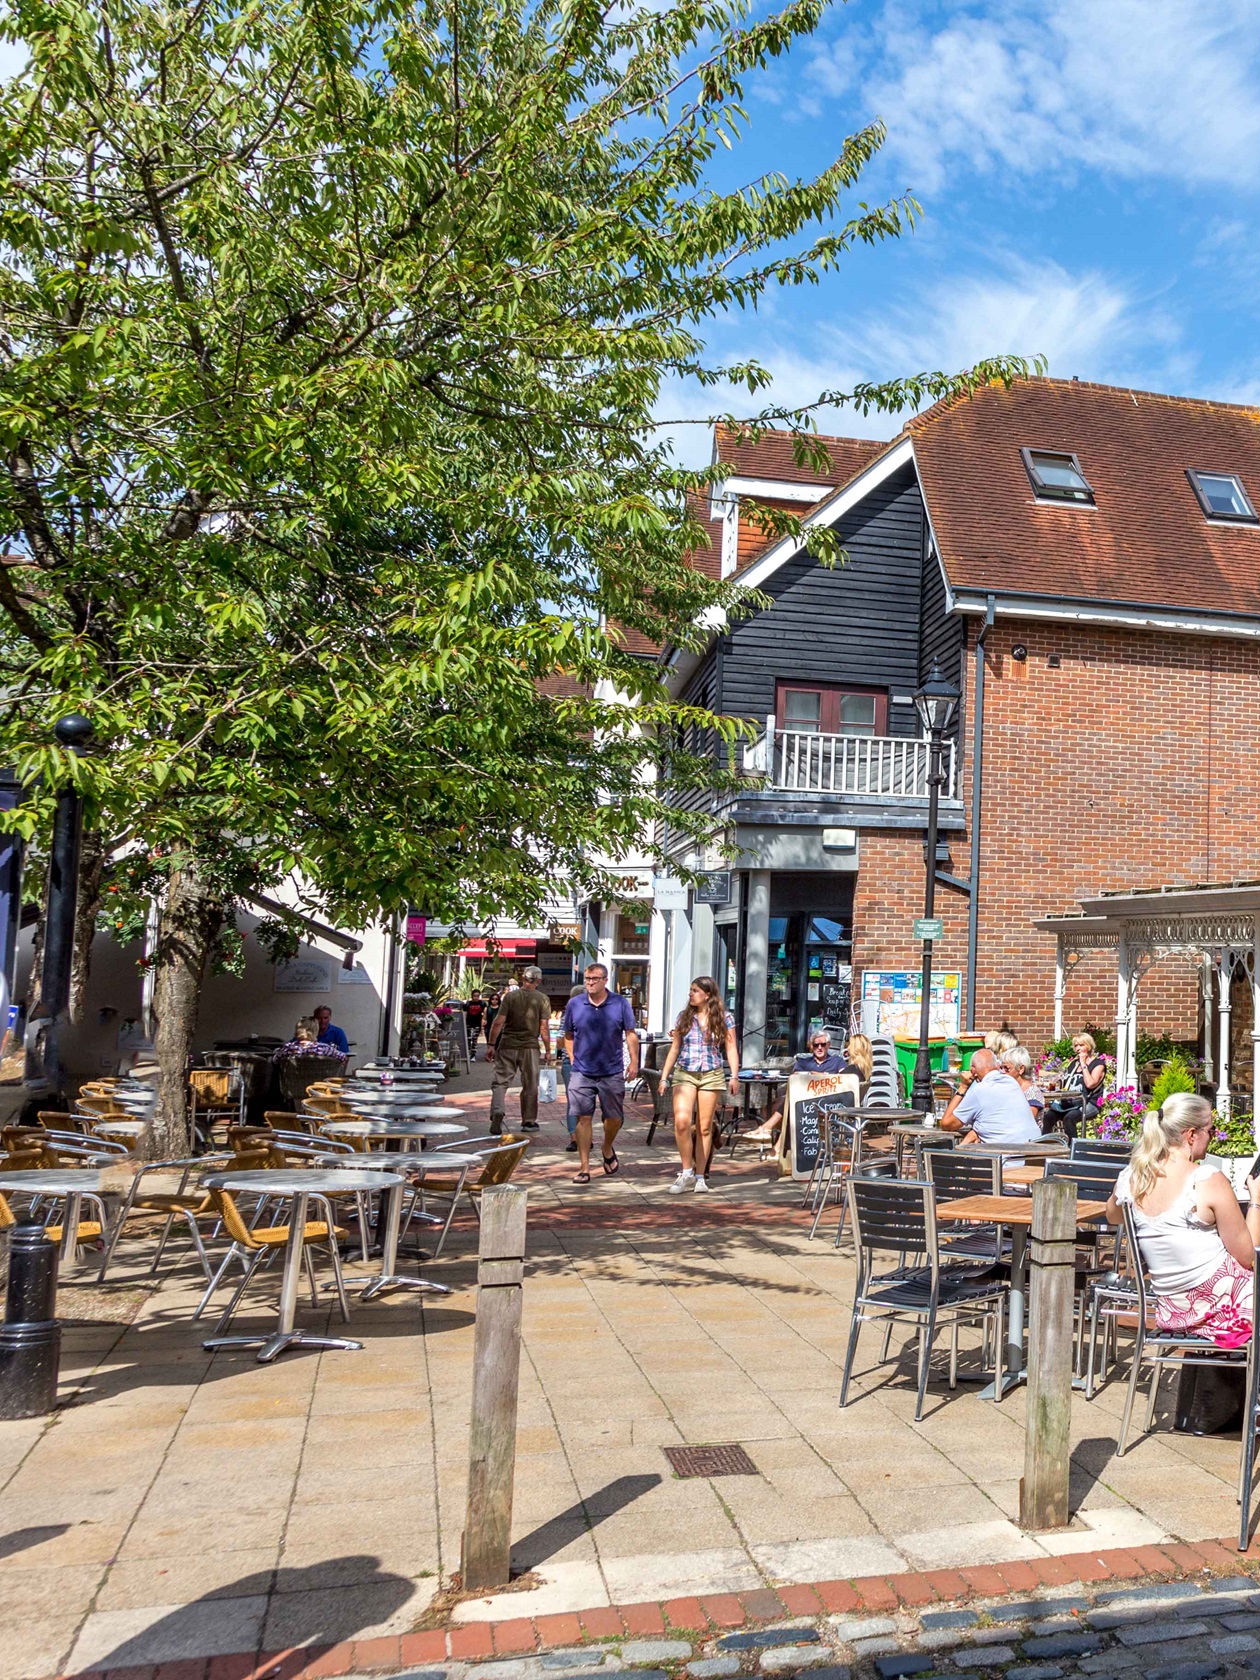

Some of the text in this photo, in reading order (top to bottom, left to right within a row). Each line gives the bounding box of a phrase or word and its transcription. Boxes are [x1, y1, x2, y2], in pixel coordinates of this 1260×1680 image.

[553, 926, 578, 936] COOK
[807, 1076, 843, 1092] APEROL
[813, 1085, 838, 1097] SPRITZ
[802, 1101, 815, 1114] Ice
